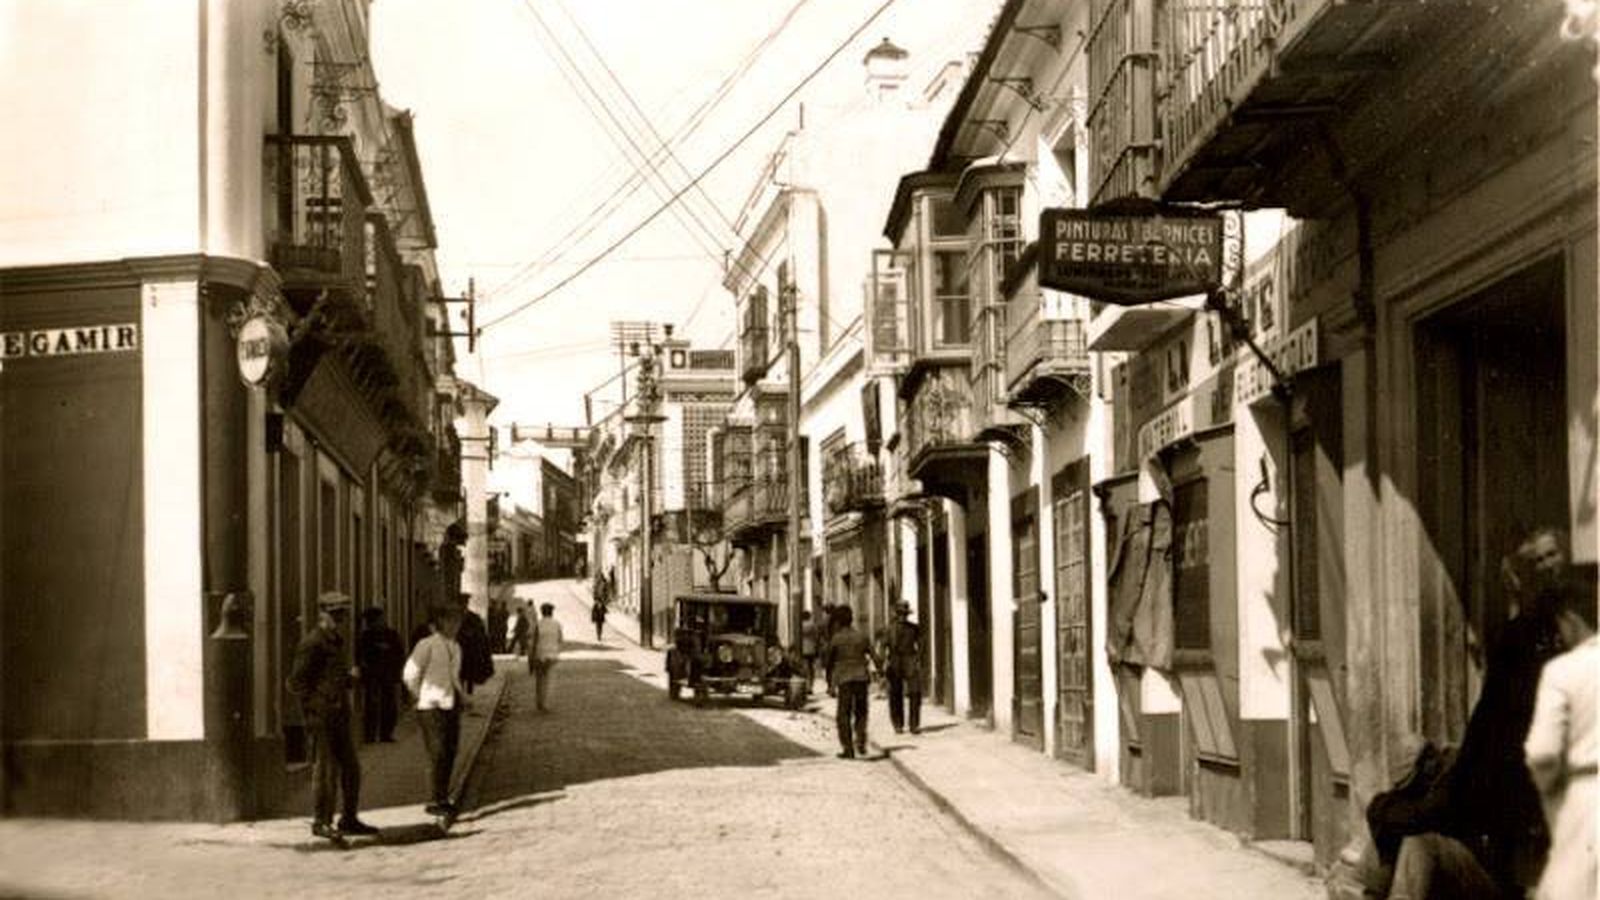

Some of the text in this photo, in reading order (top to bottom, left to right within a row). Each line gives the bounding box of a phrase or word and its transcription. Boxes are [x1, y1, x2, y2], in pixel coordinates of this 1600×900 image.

[1055, 219, 1128, 241] PINTURAS
[1055, 242, 1213, 266] FERRETERIA
[31, 327, 134, 353] GAMIR
